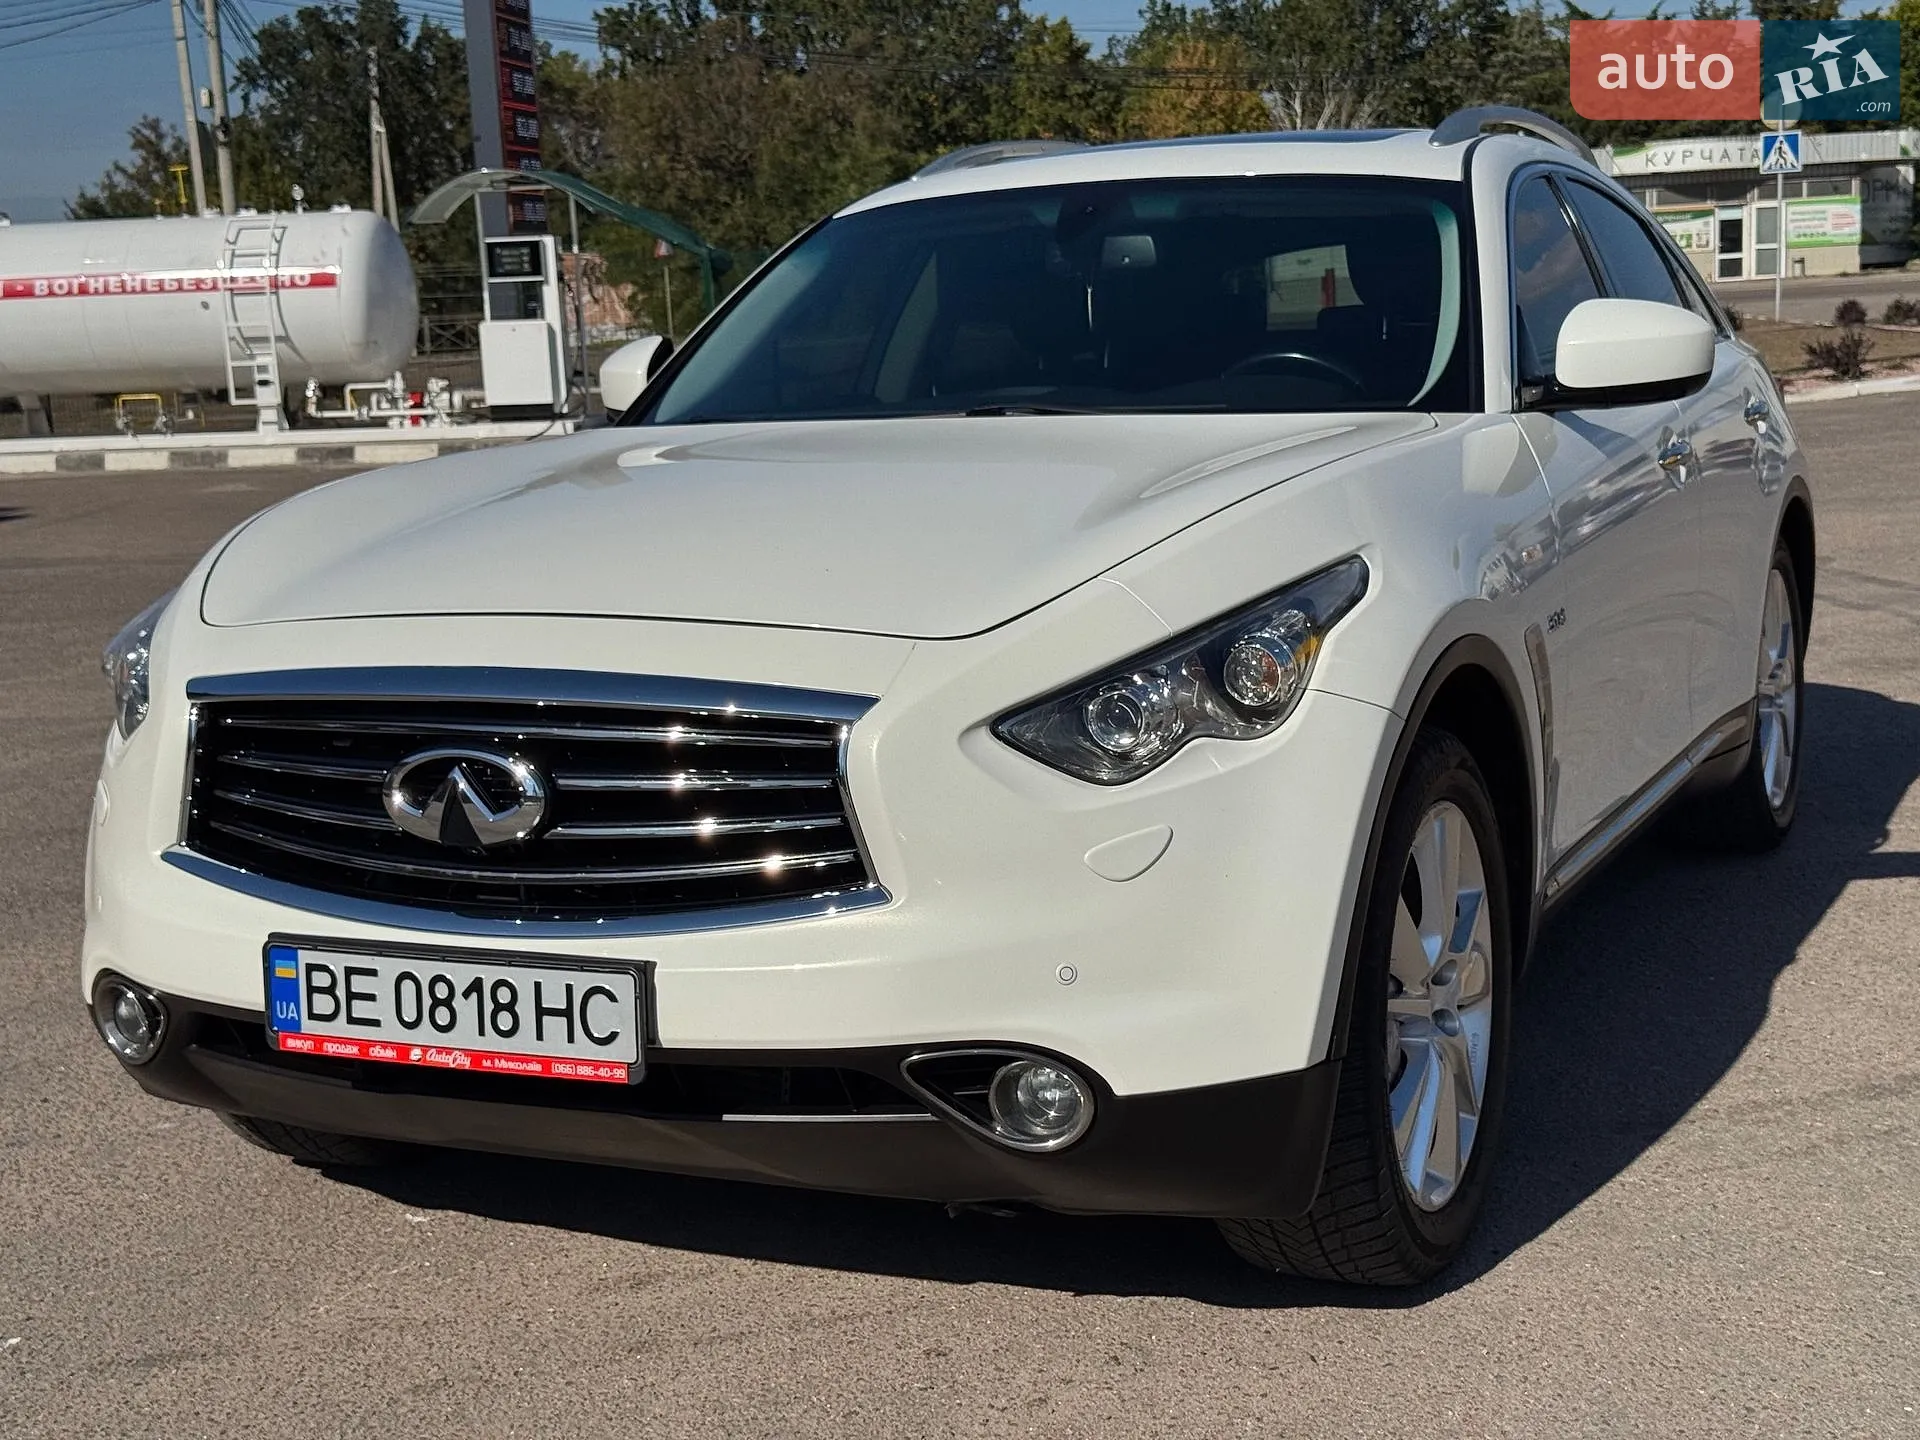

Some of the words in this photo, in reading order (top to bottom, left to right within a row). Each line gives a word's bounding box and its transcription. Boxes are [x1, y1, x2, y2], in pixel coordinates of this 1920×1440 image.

[276, 1001, 299, 1021] UA
[305, 962, 383, 1028] BE
[394, 970, 520, 1039] 0818
[534, 980, 621, 1046] HC
[286, 1037, 315, 1051] викуп
[323, 1041, 360, 1056] продаж
[368, 1044, 397, 1059] обмін
[426, 1050, 472, 1069] AutoCity
[494, 1058, 542, 1072] Миколаїв
[552, 1063, 576, 1076] (066)
[577, 1065, 626, 1080] 886-40-99
